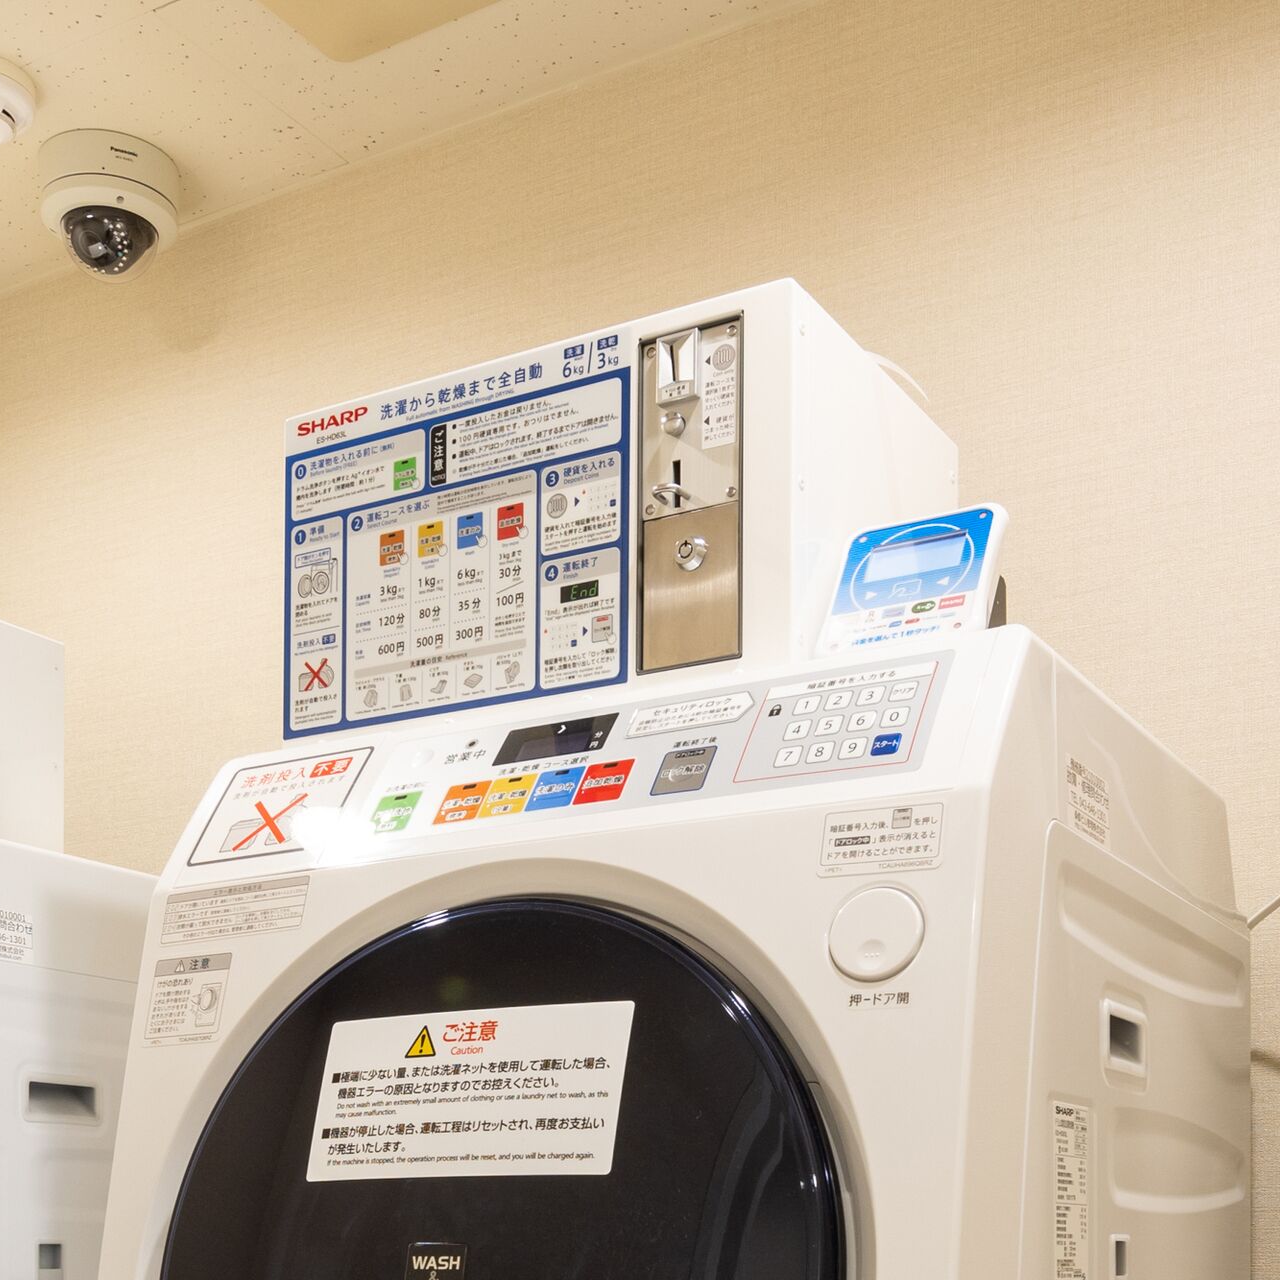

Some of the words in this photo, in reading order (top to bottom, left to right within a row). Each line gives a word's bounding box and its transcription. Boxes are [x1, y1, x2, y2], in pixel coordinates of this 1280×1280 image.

[380, 362, 543, 421] 洗濯から乾燥まで全自動
[297, 406, 369, 437] SHARP
[563, 455, 616, 479] 硬貨を入れる
[366, 497, 430, 524] 運転コースを選ぶ
[561, 555, 598, 574] 運転終了
[495, 591, 525, 608] 100円
[569, 580, 597, 601] End
[418, 604, 441, 620] 80分
[457, 596, 481, 612] 35分
[377, 611, 405, 629] 120分
[416, 632, 444, 649] 500円
[455, 624, 484, 642] 300円
[377, 640, 405, 657] 600円
[653, 696, 733, 717] セキュリティロック
[831, 695, 843, 706] 2
[864, 690, 875, 701] 3
[790, 724, 802, 735] 4
[822, 718, 835, 731] 5
[854, 714, 867, 726] 6
[887, 710, 901, 723] 0
[443, 746, 487, 765] 営業中
[782, 750, 793, 762] 7
[812, 745, 826, 758] 8
[845, 741, 858, 753] 9
[872, 737, 899, 749] スタート
[240, 764, 308, 789] 洗剤投入
[441, 1020, 498, 1043] ご注意
[450, 1044, 484, 1056] Caution
[336, 1075, 561, 1098] 機器エラーの原因となりますのでお控えください。
[1054, 1105, 1075, 1119] SHARP
[326, 1139, 408, 1155] が発生いたします。
[412, 1256, 461, 1271] WASH
